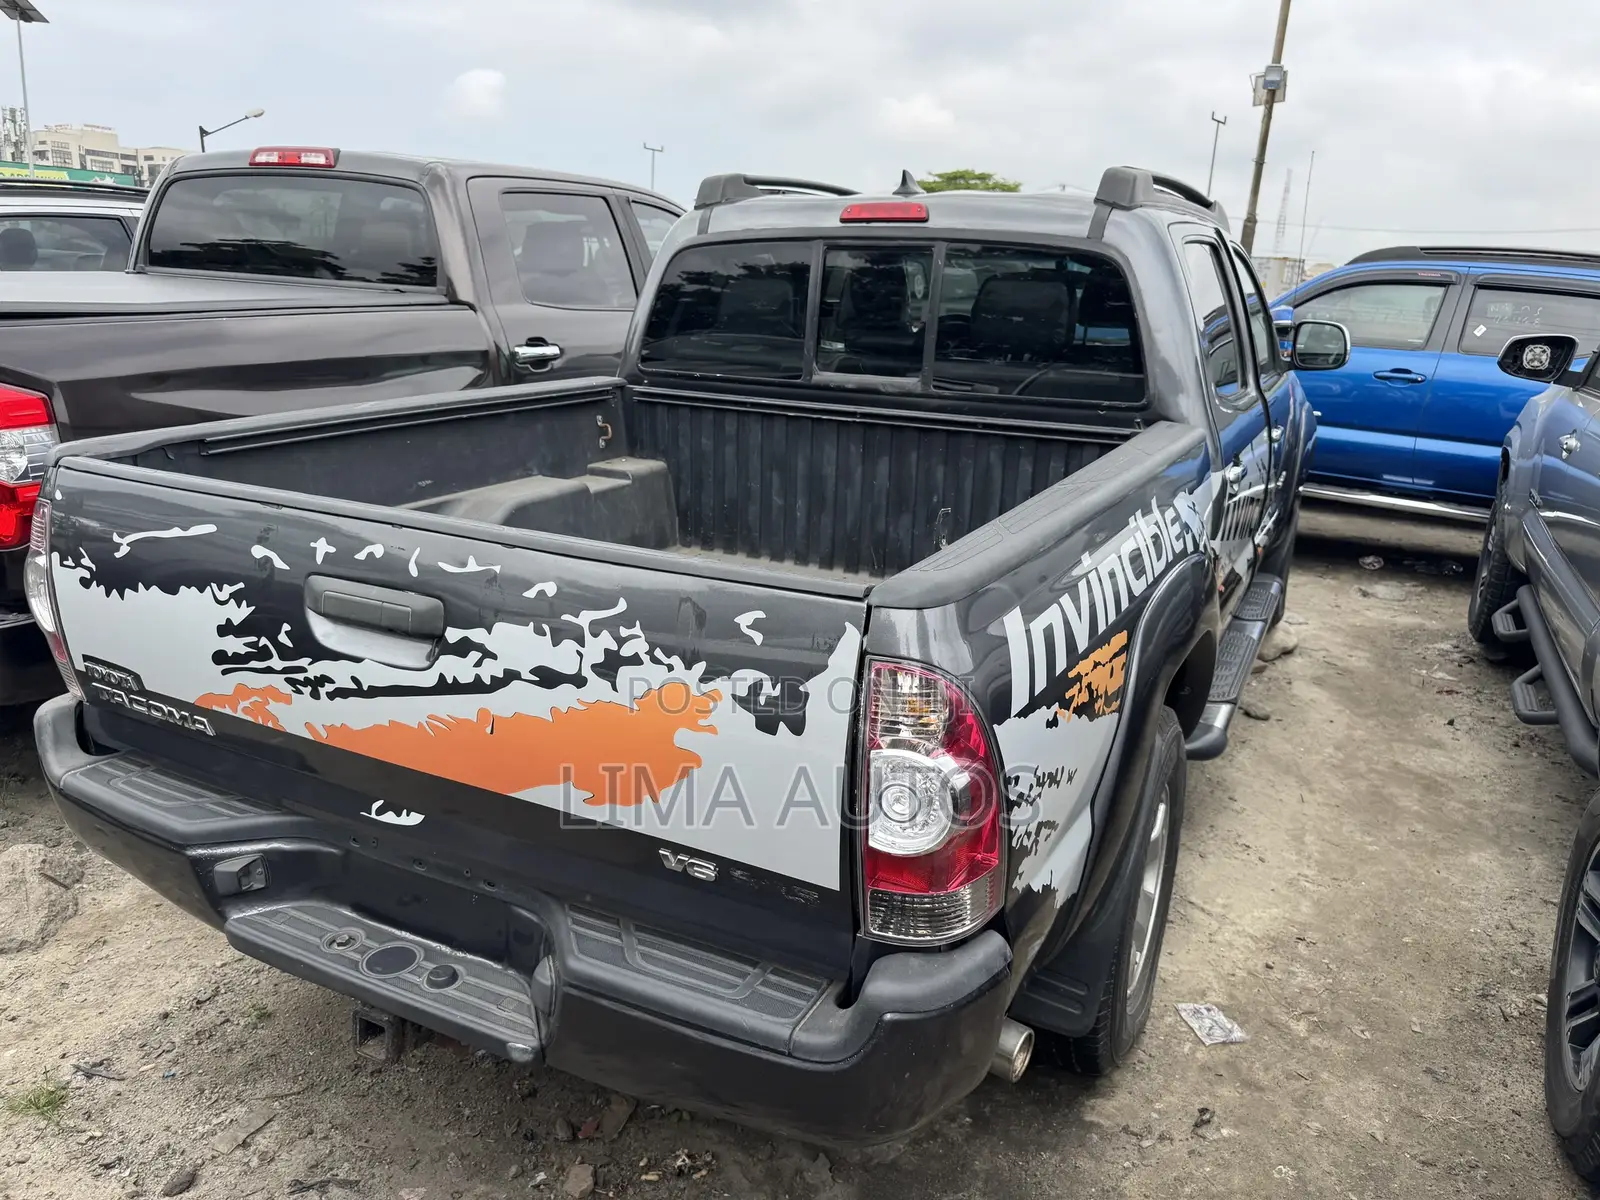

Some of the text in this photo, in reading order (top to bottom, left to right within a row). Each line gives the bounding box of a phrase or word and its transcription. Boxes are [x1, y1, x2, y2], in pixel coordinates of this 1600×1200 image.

[1003, 496, 1185, 718] Invincible
[84, 661, 139, 691] TOYOTA
[92, 682, 216, 737] TACOMA
[658, 848, 717, 882] V6
